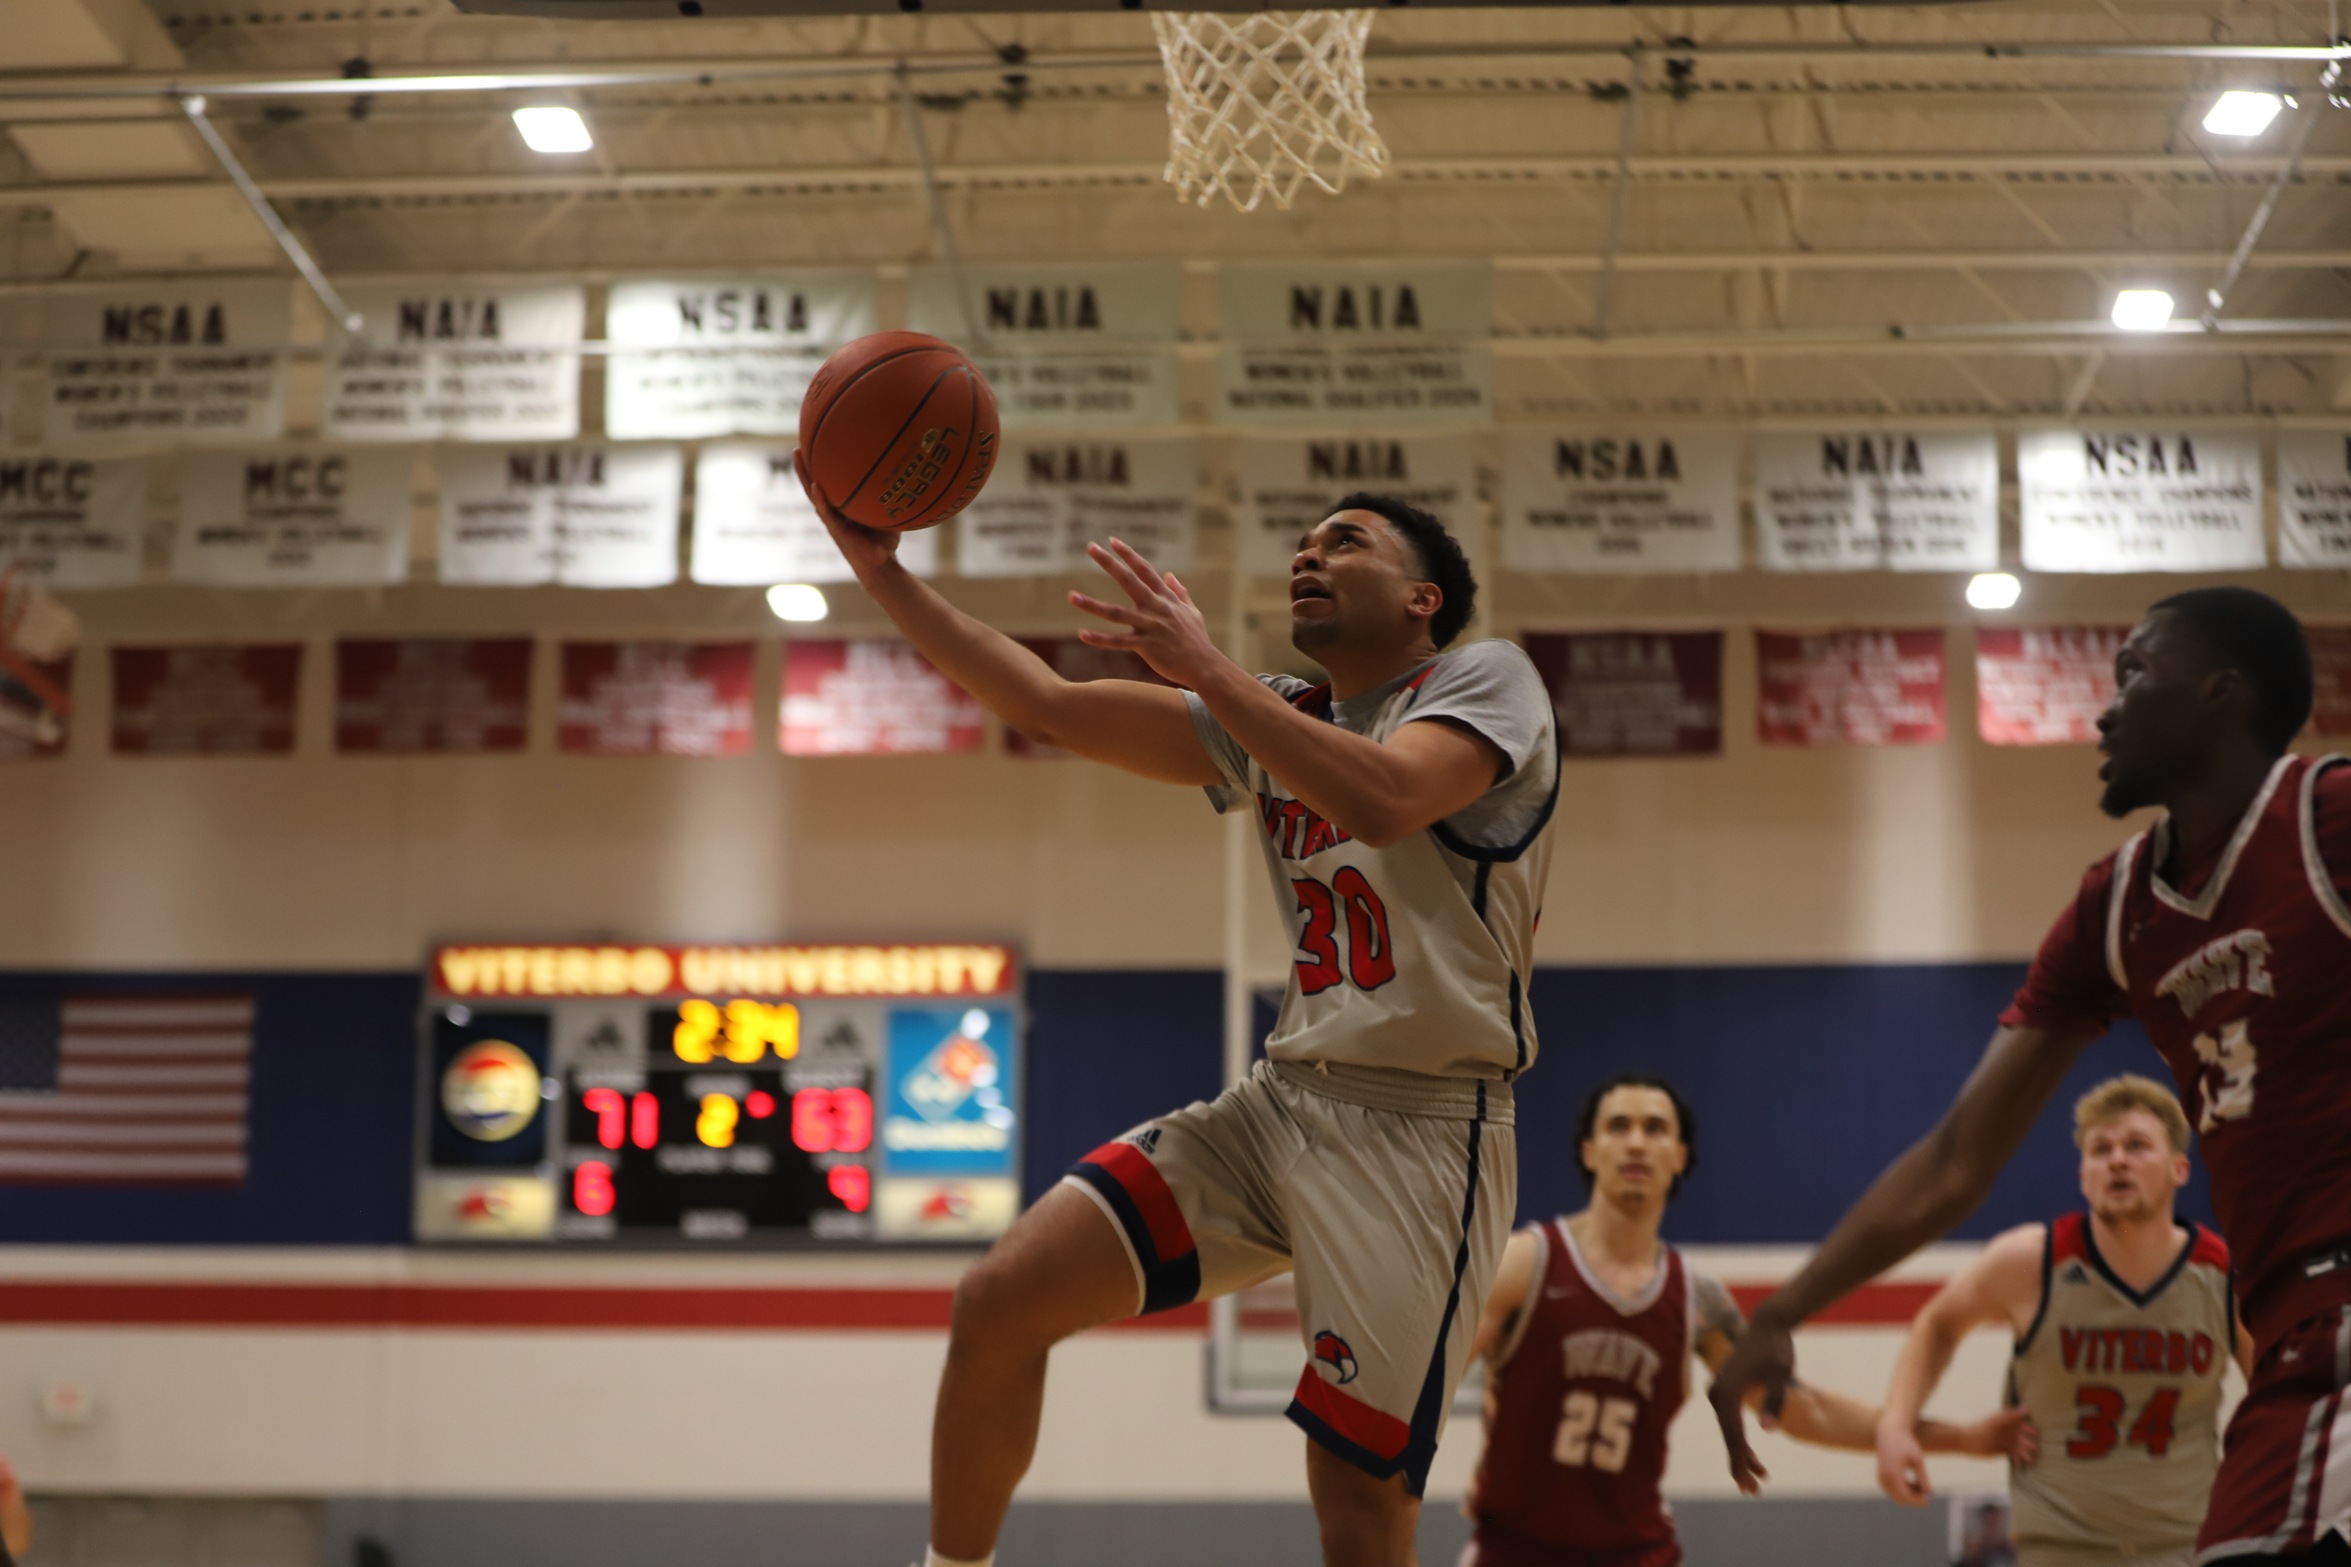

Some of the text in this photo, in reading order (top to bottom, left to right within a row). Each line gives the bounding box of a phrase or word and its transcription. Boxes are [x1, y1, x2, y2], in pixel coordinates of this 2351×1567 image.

[103, 304, 227, 346] NSAA
[399, 298, 500, 341] NAIA
[986, 285, 1102, 331] NAIA
[1289, 283, 1422, 330] NAIA
[887, 427, 960, 518] LEGACY
[1027, 445, 1132, 487] NAIA
[1307, 439, 1409, 481] NAIA
[1554, 437, 1682, 481] NSAA
[1822, 433, 1924, 477] NAIA
[2083, 434, 2198, 476] NSAA
[245, 457, 348, 501] MCC
[905, 430, 995, 531] SPALDI
[1291, 865, 1397, 997] 30
[440, 947, 1007, 994] VITERBO UNIVERSITY
[583, 1088, 659, 1149] 71
[2059, 1325, 2214, 1377] VITERBO
[1552, 1389, 1638, 1474] 25
[2066, 1383, 2182, 1459] 34
